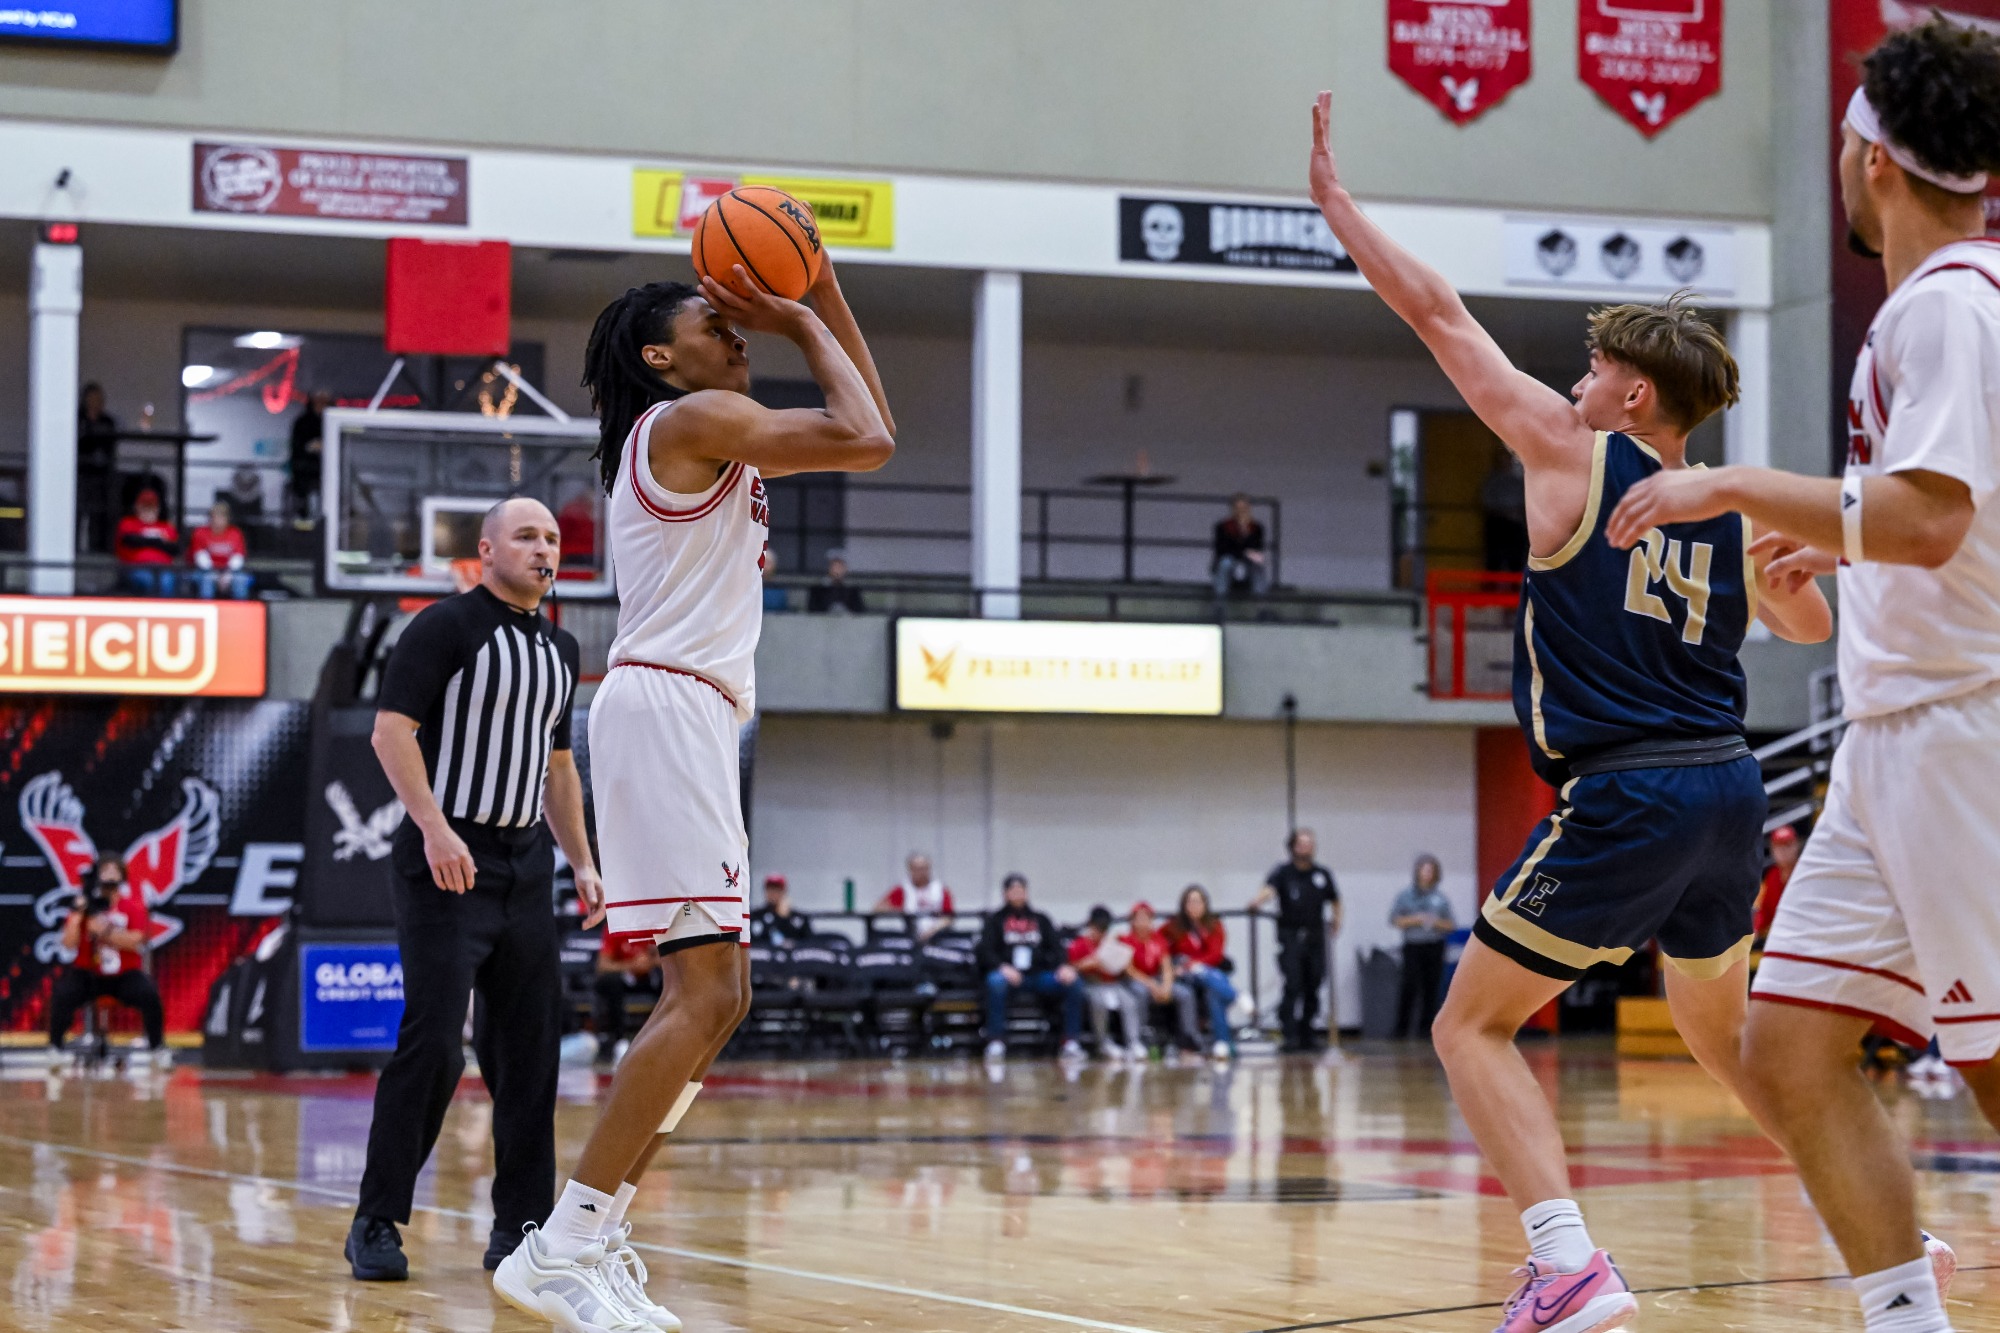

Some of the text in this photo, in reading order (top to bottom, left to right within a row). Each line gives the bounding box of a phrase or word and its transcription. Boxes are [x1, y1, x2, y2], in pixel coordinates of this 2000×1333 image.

[1394, 21, 1528, 51] BASKETBALL
[1586, 33, 1715, 63] BASKETBALL
[779, 200, 821, 255] NCAA
[1624, 527, 1713, 645] 24
[0, 620, 196, 674] ECU
[968, 658, 1202, 681] PRIORITY TAX RELIEF
[314, 962, 404, 988] GLOBA
